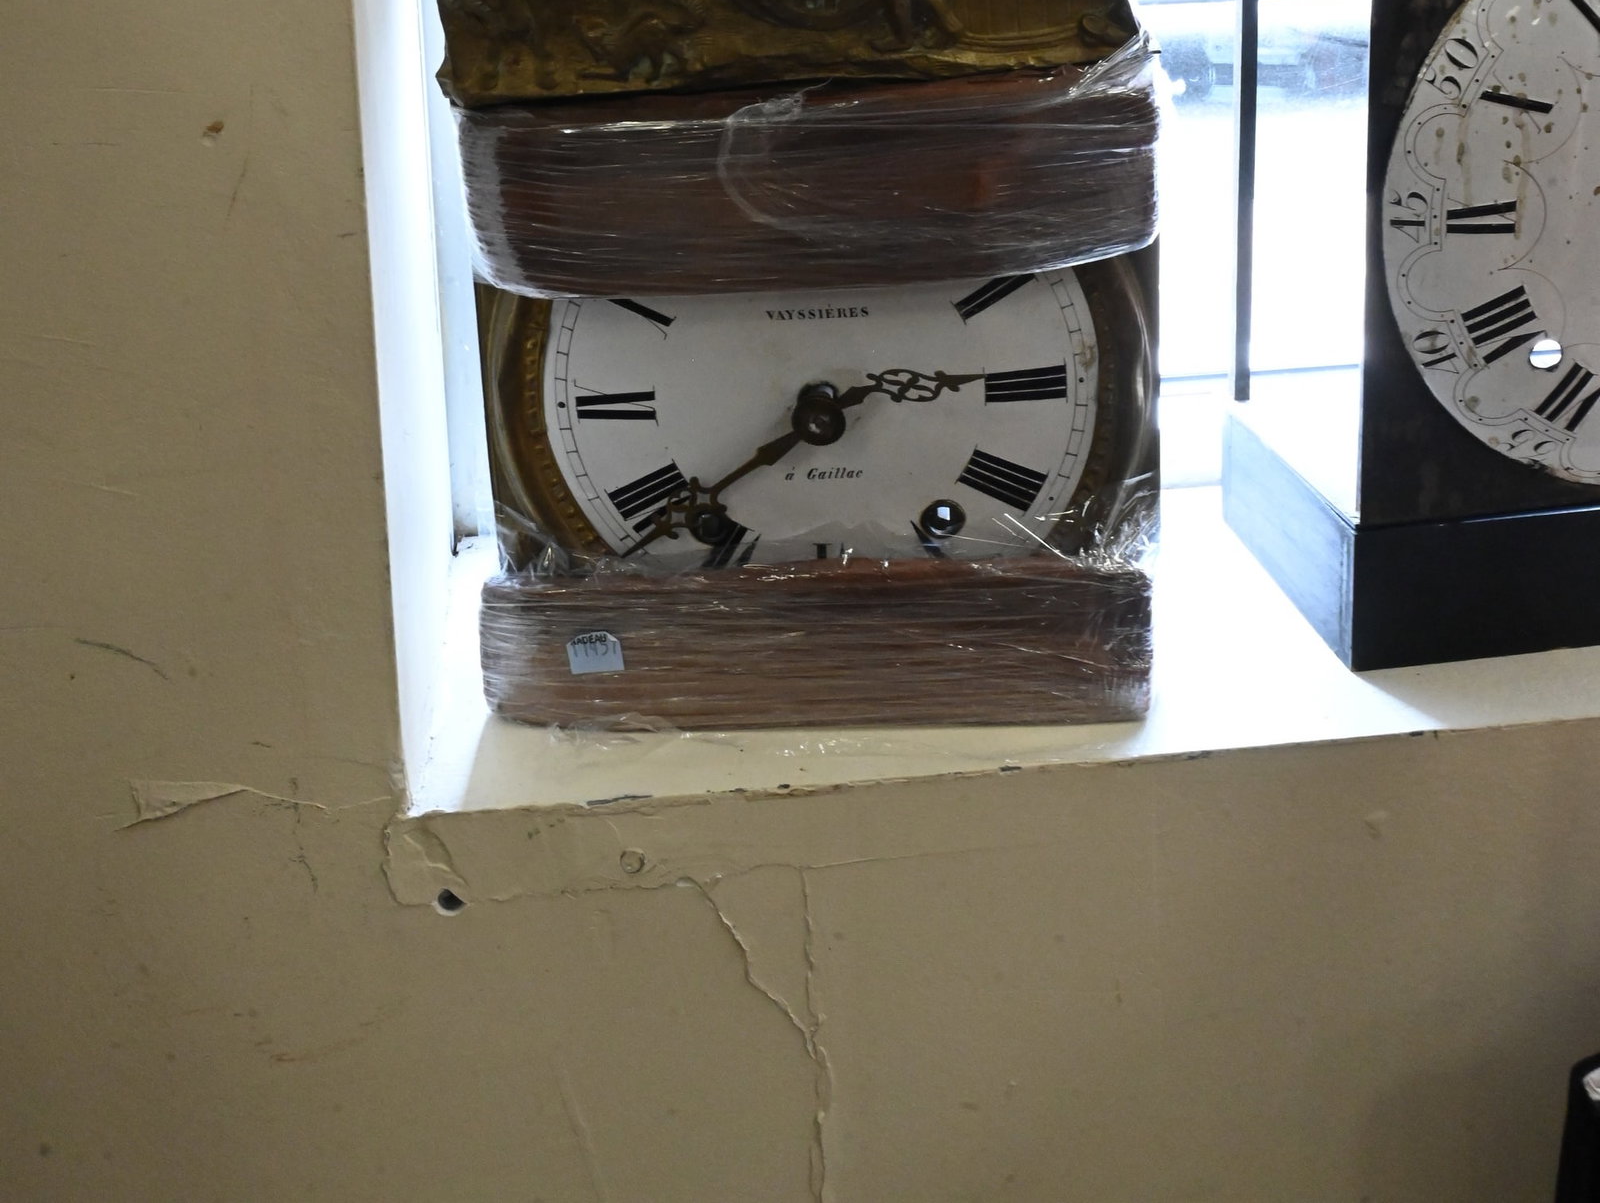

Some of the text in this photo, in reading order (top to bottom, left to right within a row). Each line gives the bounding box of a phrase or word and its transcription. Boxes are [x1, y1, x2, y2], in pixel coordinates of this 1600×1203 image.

[1423, 37, 1480, 100] 50
[1388, 189, 1429, 244] 45
[1413, 329, 1460, 374] 40
[983, 357, 1068, 405] III
[806, 466, 864, 481] Gaillac
